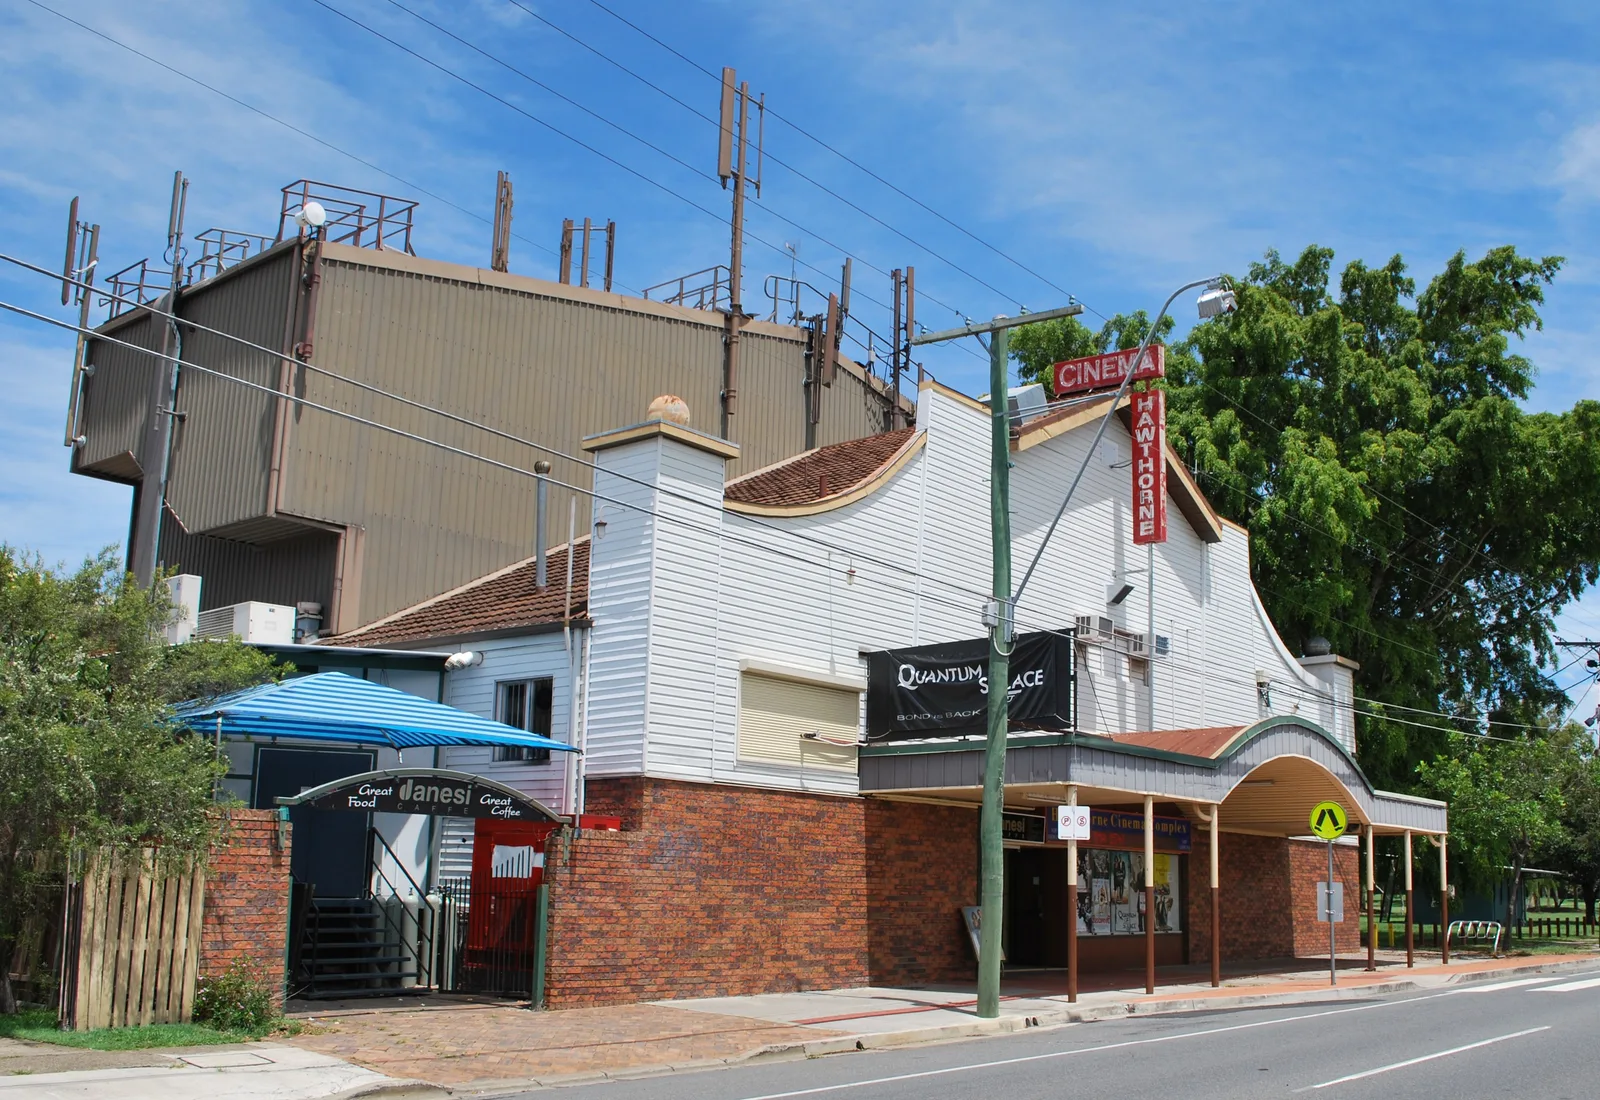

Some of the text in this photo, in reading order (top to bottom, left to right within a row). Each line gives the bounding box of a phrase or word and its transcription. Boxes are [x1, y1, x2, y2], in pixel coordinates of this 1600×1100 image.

[1059, 351, 1156, 388] CINEMA
[1134, 396, 1157, 537] HAWTHORNE
[897, 664, 982, 690] QUANTUM
[978, 669, 1044, 694] SACE
[945, 709, 981, 719] BACK
[347, 795, 377, 808] Food
[358, 784, 393, 796] Great
[399, 779, 473, 805] danesi
[479, 793, 512, 806] Great
[490, 805, 521, 819] Coffee
[1110, 813, 1145, 830] Cinema
[1155, 820, 1187, 836] omplex
